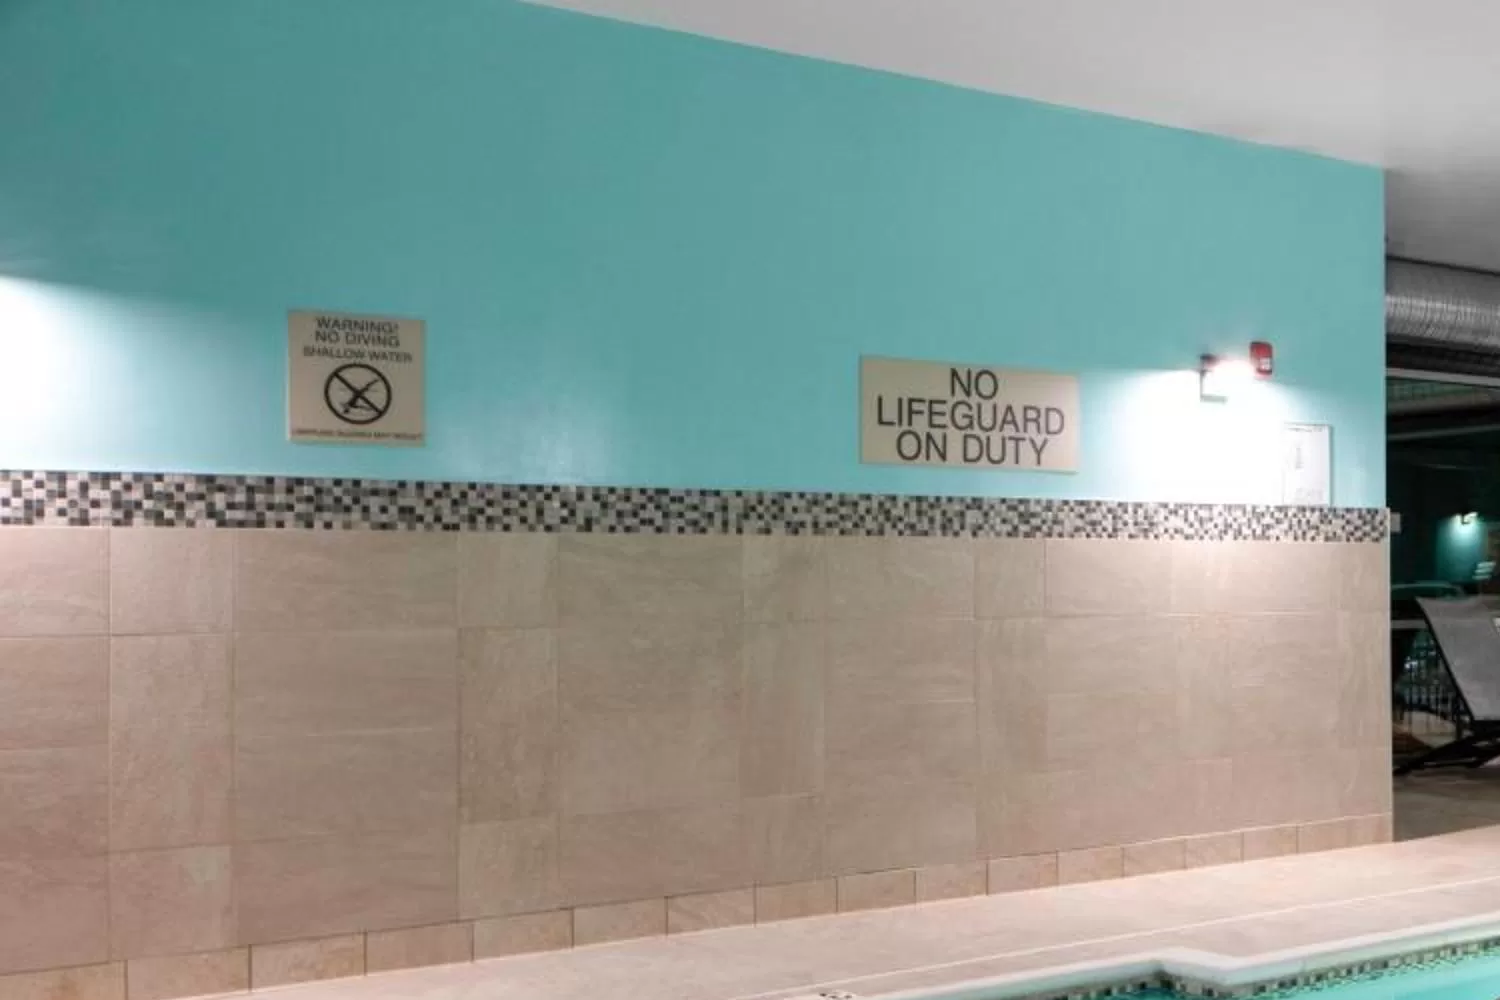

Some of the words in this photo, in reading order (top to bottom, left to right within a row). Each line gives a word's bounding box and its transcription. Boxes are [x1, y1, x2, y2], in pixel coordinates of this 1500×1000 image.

[315, 331, 340, 343] NO
[345, 332, 400, 348] DIVING
[950, 368, 999, 400] NO
[877, 395, 1065, 435] LIFEGUARD
[896, 430, 948, 462] ON
[963, 434, 1048, 466] DUTY
